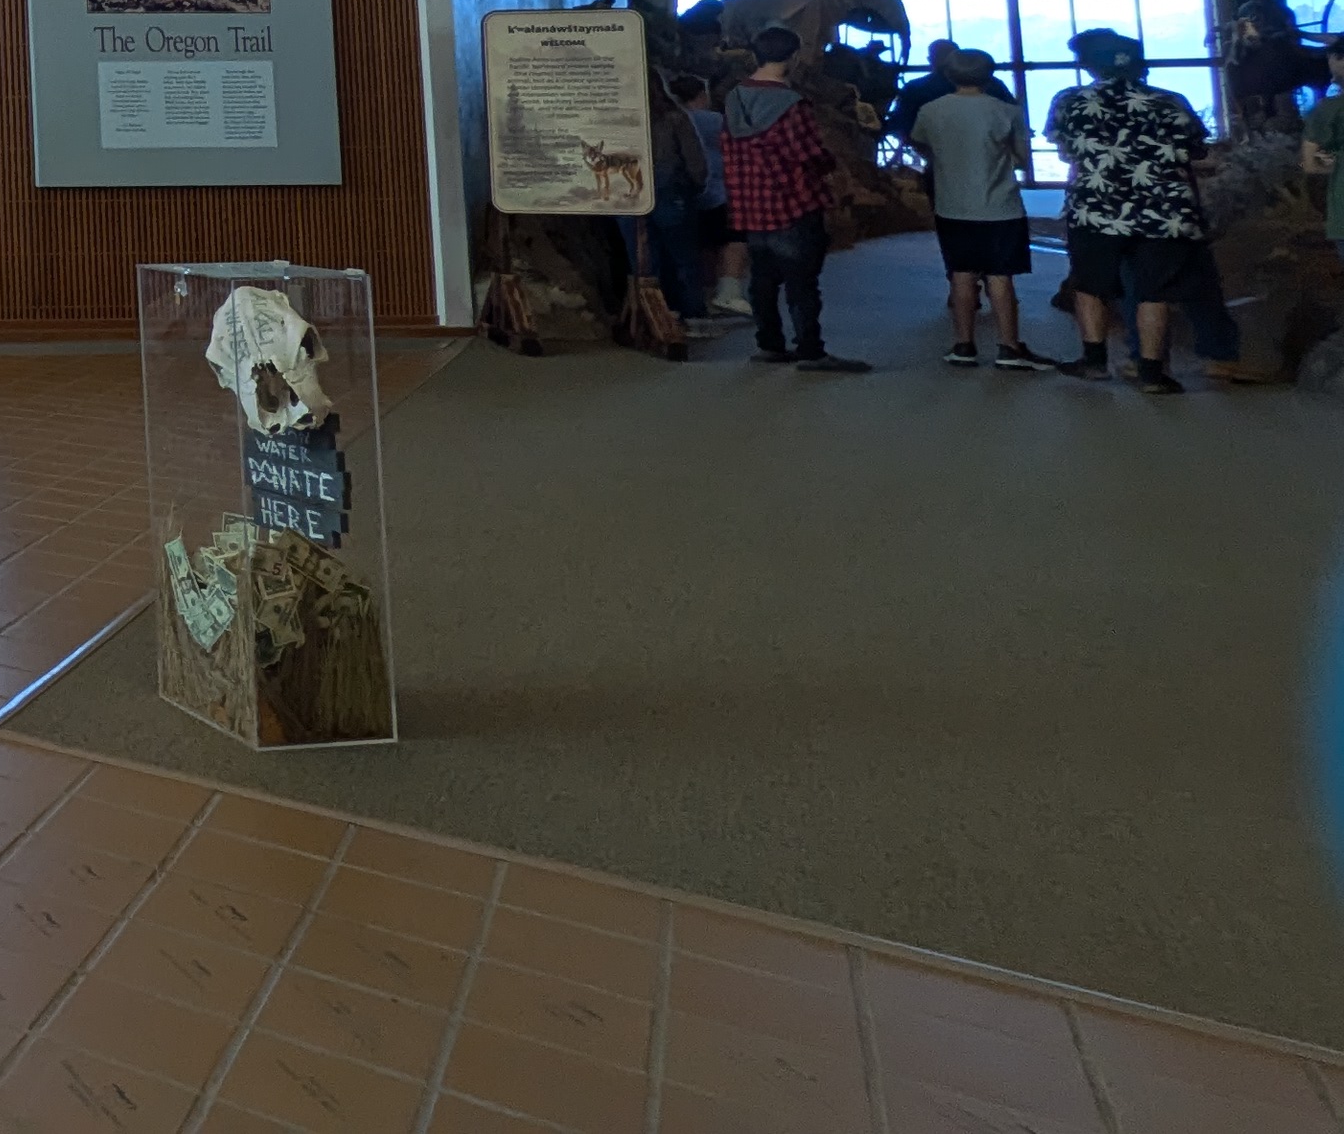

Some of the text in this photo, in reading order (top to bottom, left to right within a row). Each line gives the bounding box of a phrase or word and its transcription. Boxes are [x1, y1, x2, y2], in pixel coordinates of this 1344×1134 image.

[93, 25, 274, 58] The Oregon Trail
[254, 437, 312, 463] WATER
[260, 497, 325, 540] HERE
